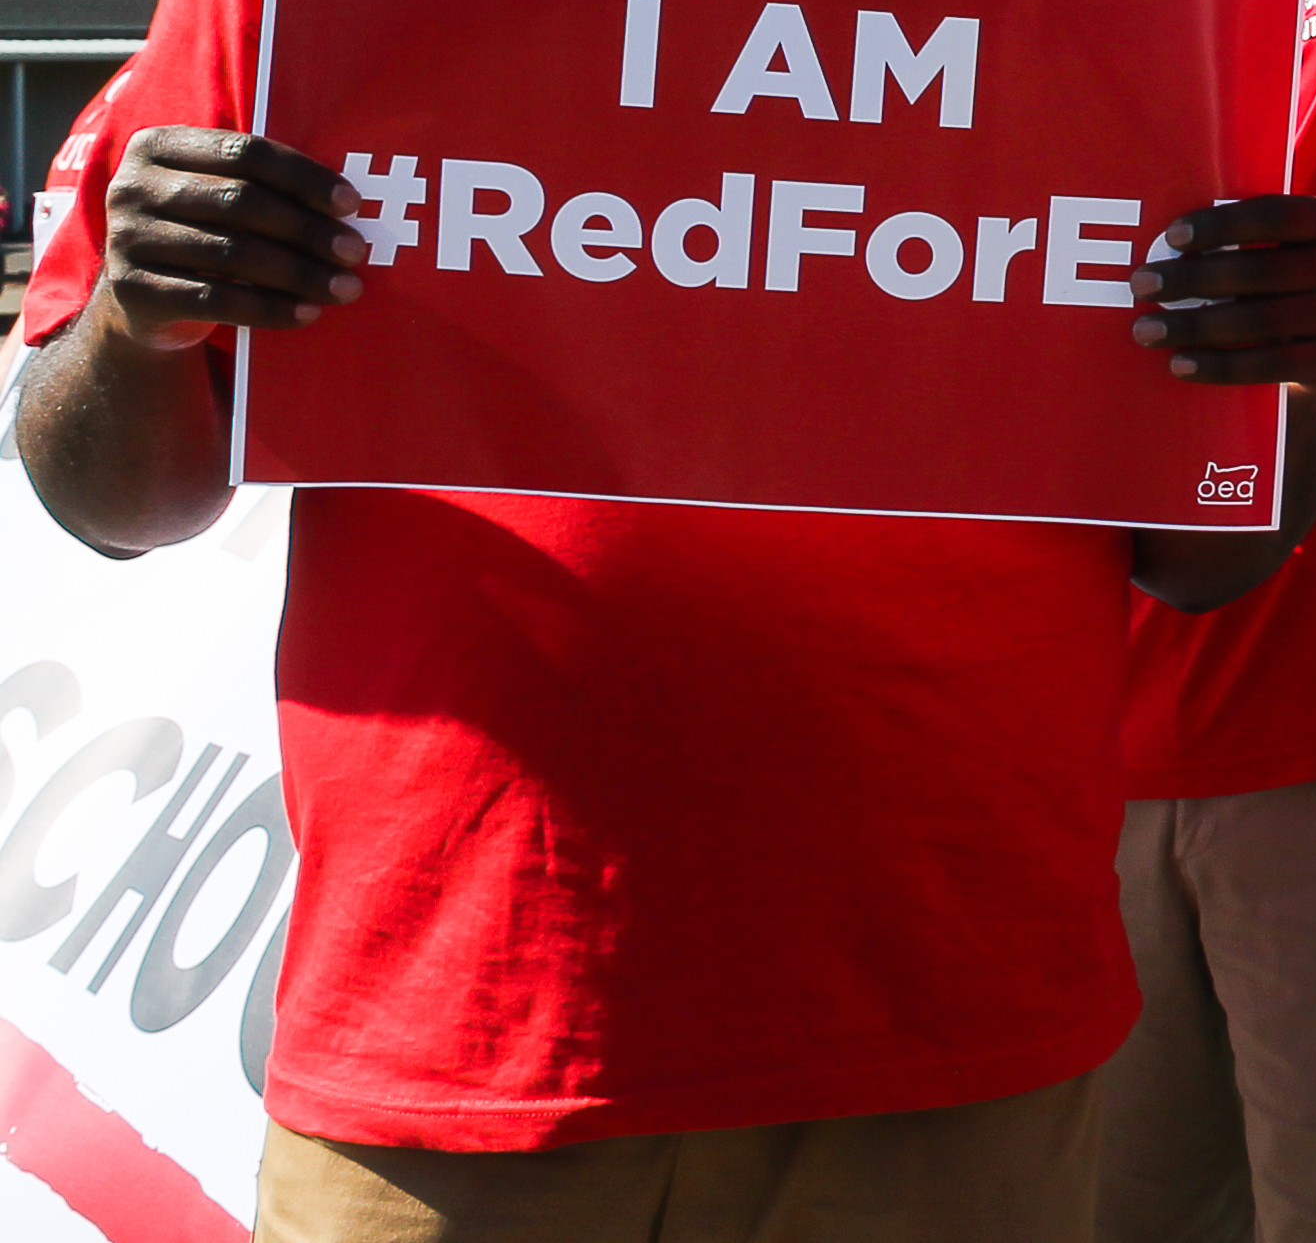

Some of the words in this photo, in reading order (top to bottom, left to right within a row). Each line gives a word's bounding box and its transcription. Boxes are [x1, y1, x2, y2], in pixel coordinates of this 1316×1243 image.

[710, 2, 980, 129] AM
[340, 152, 1240, 310] #RedForE
[1197, 480, 1255, 498] oea
